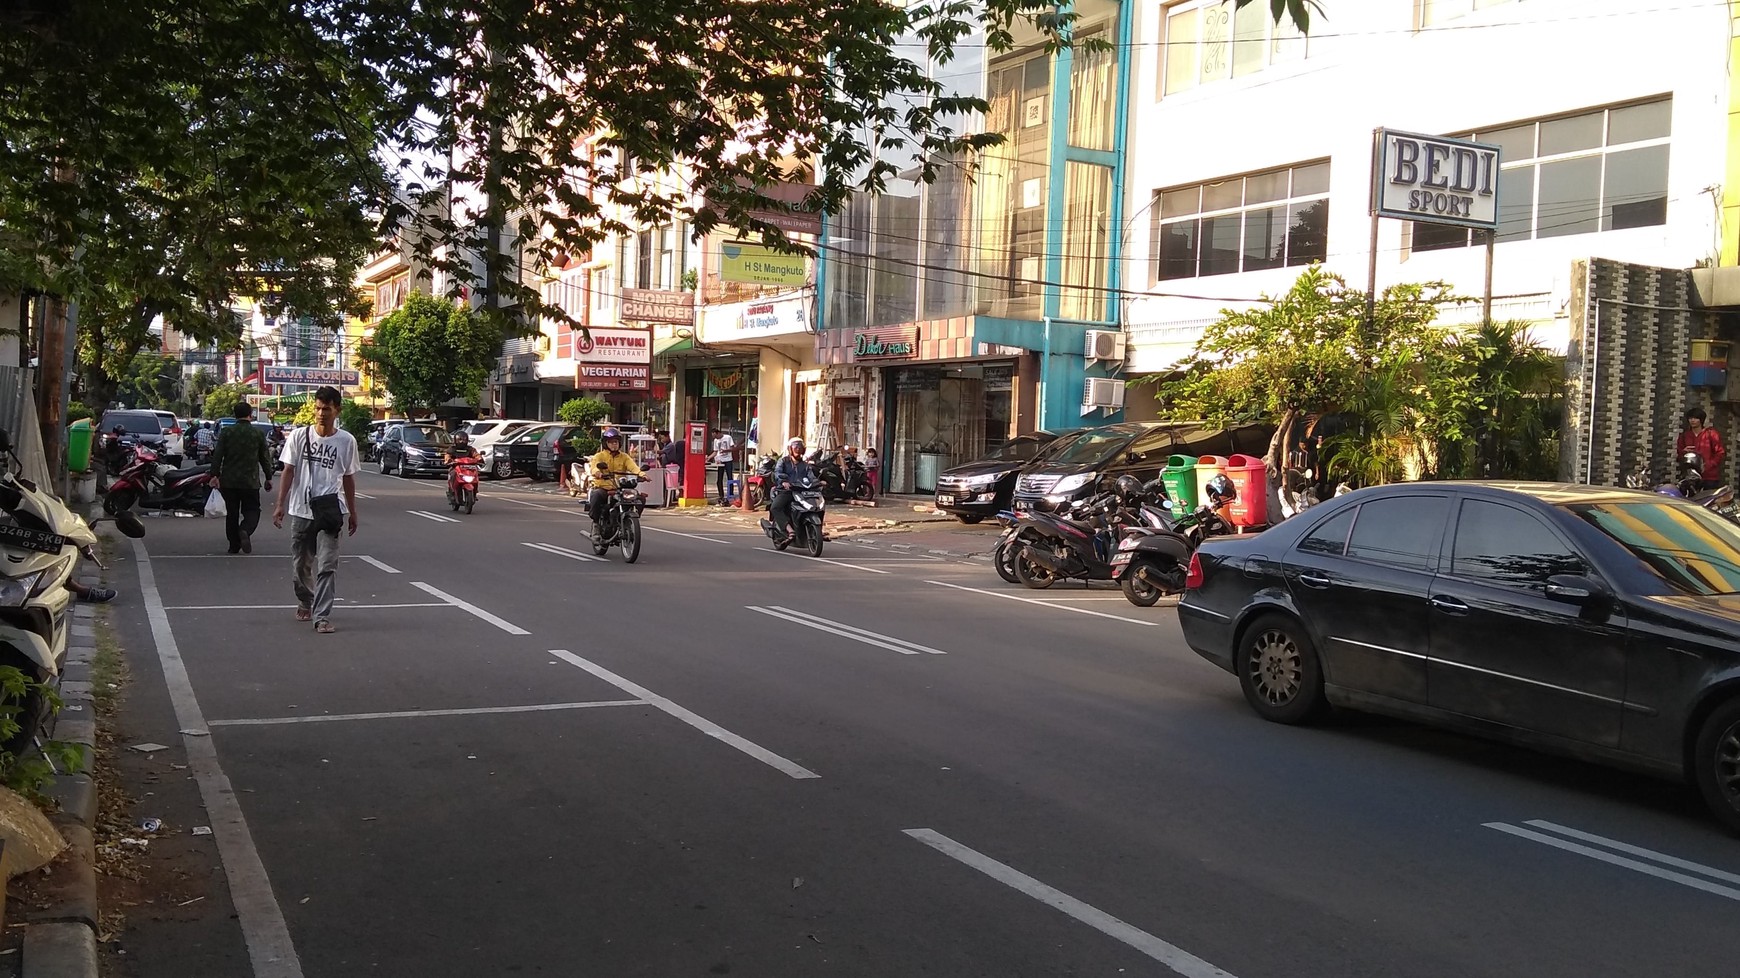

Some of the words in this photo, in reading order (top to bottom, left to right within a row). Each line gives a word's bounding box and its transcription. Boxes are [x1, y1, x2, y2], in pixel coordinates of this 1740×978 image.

[1390, 137, 1495, 197] BEDI
[1408, 189, 1473, 217] SPORT
[744, 262, 751, 271] H
[753, 262, 762, 272] St
[763, 263, 804, 277] Mangkuto
[632, 292, 686, 305] MONEY
[622, 303, 694, 319] CHANGER
[595, 336, 646, 347] WAYTUKI
[853, 333, 889, 356] Dekor
[268, 369, 303, 379] RAJA
[306, 371, 356, 381] SPORTS
[581, 366, 647, 378] VEGETARIAN
[303, 441, 338, 460] OSAKA
[321, 457, 335, 470] 99
[0, 526, 32, 538] 3488
[37, 533, 63, 545] SKB
